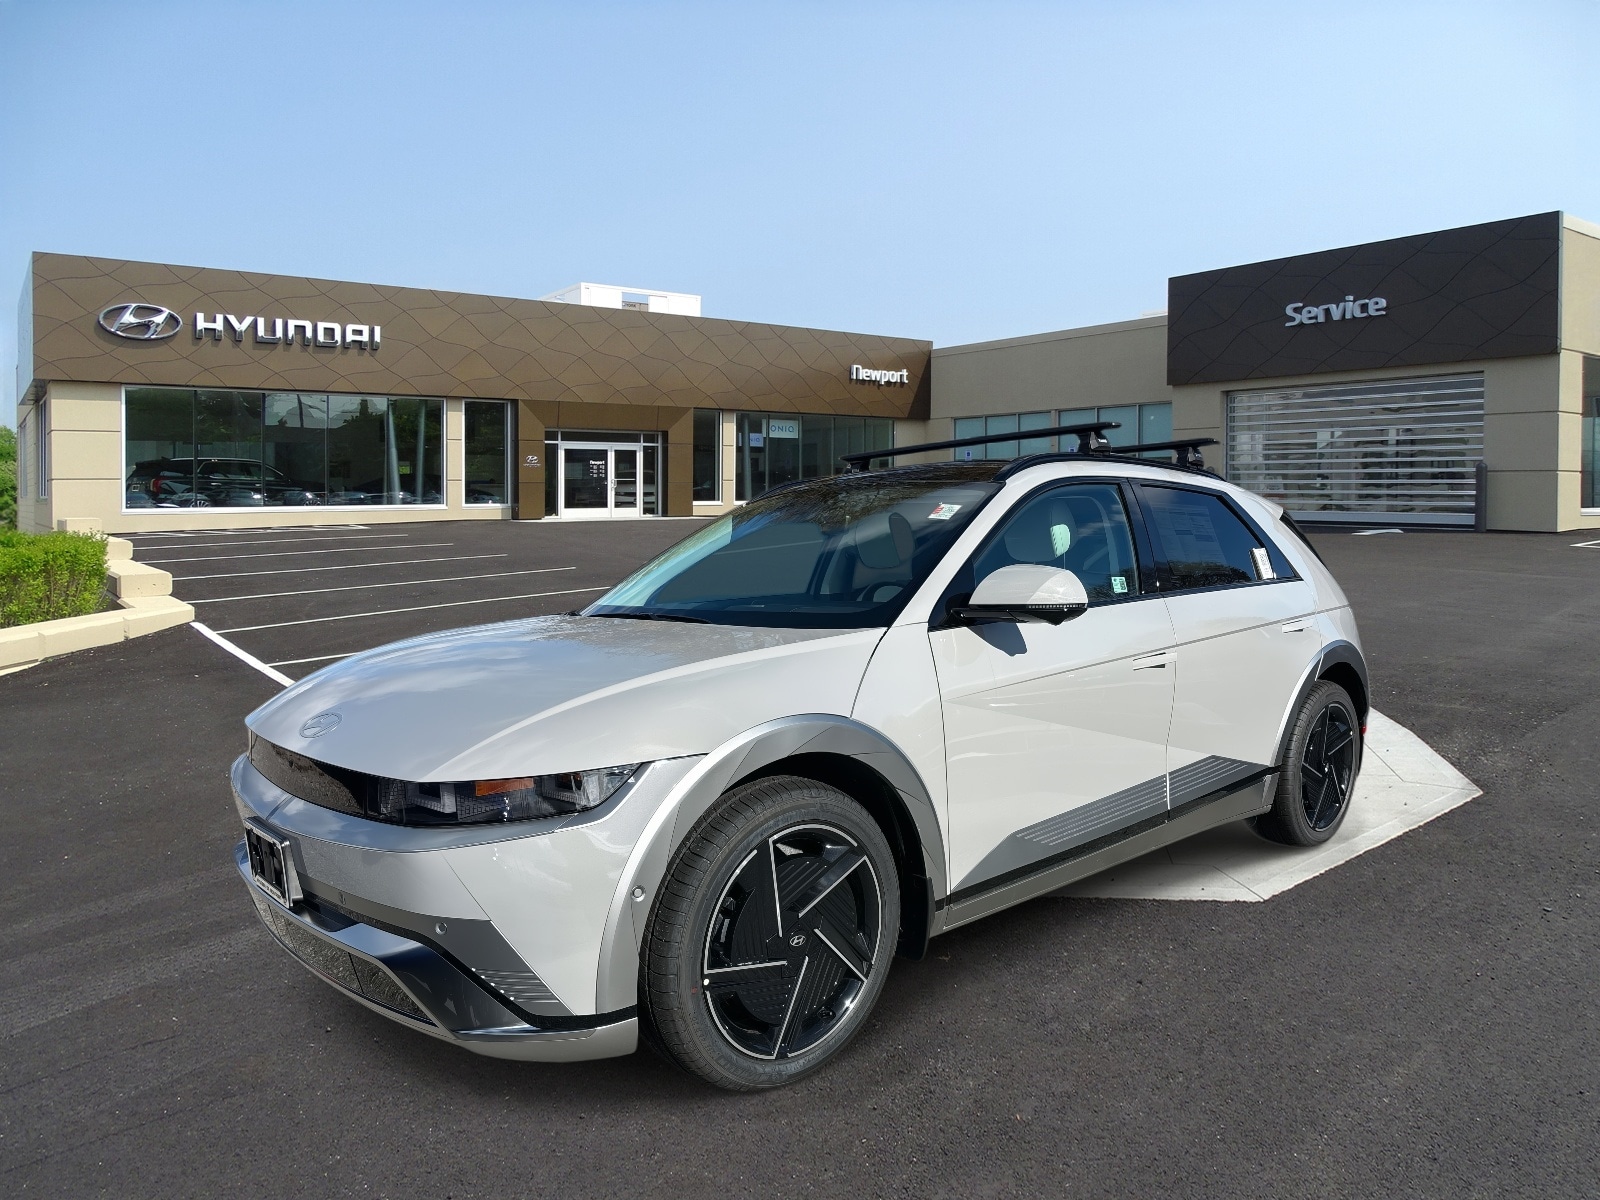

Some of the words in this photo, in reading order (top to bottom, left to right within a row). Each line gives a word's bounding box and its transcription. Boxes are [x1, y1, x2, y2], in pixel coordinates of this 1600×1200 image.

[1284, 295, 1387, 326] Service
[195, 312, 381, 350] HYUNDAI
[850, 364, 908, 385] Newport
[770, 424, 795, 433] ONIQ
